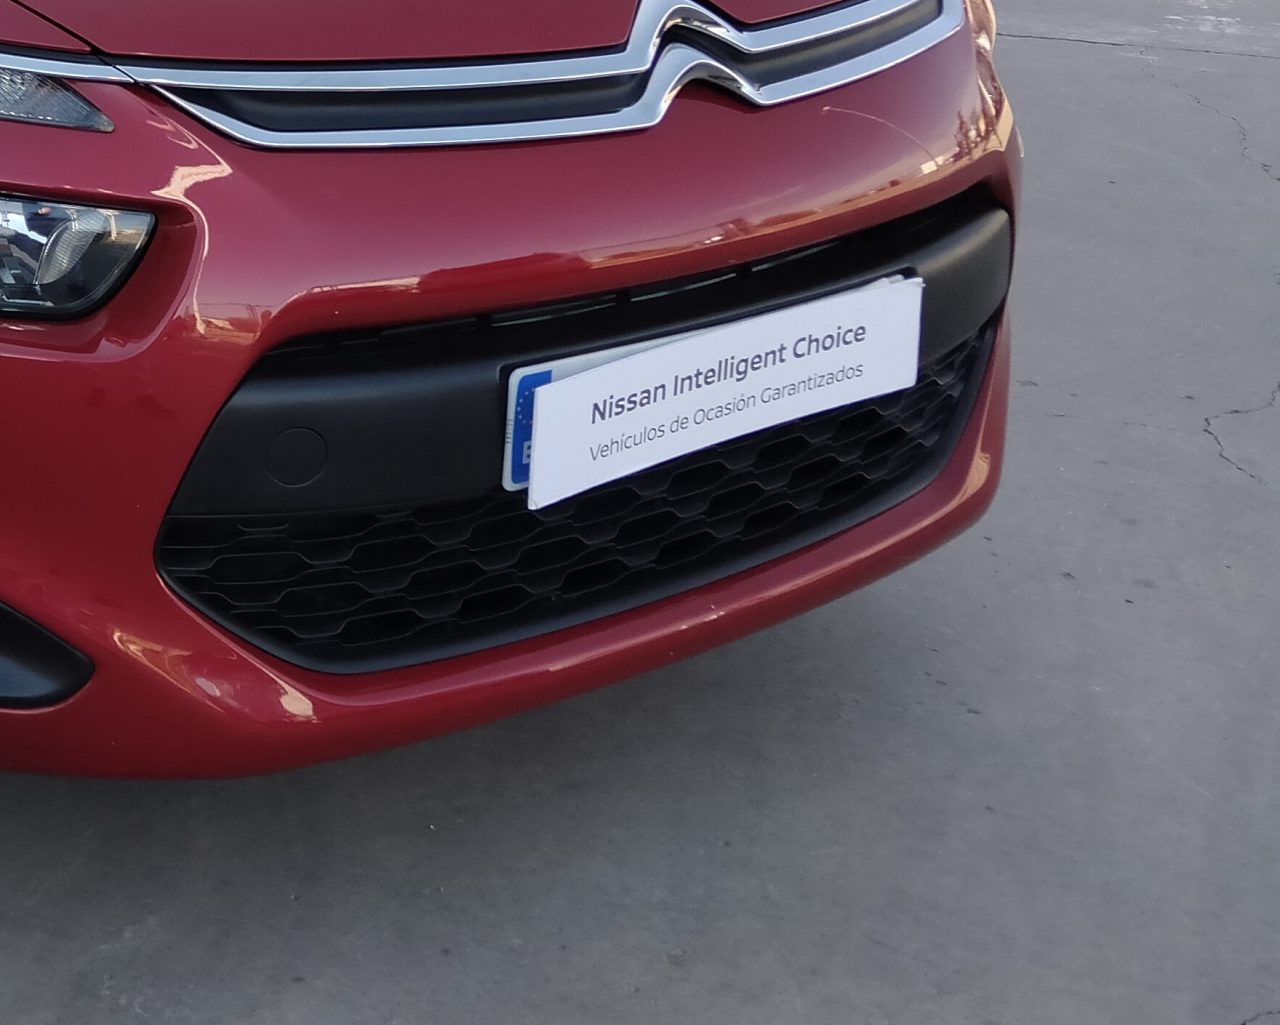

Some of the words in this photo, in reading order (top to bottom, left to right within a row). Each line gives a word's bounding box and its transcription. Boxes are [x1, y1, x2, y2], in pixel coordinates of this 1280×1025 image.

[589, 423, 666, 462] Vehículos
[669, 414, 690, 434] de
[692, 392, 757, 426] Ocasión
[760, 363, 864, 404] Garantizados
[590, 382, 666, 425] Nissan
[672, 342, 788, 397] Intelligent
[792, 325, 867, 359] Choice
